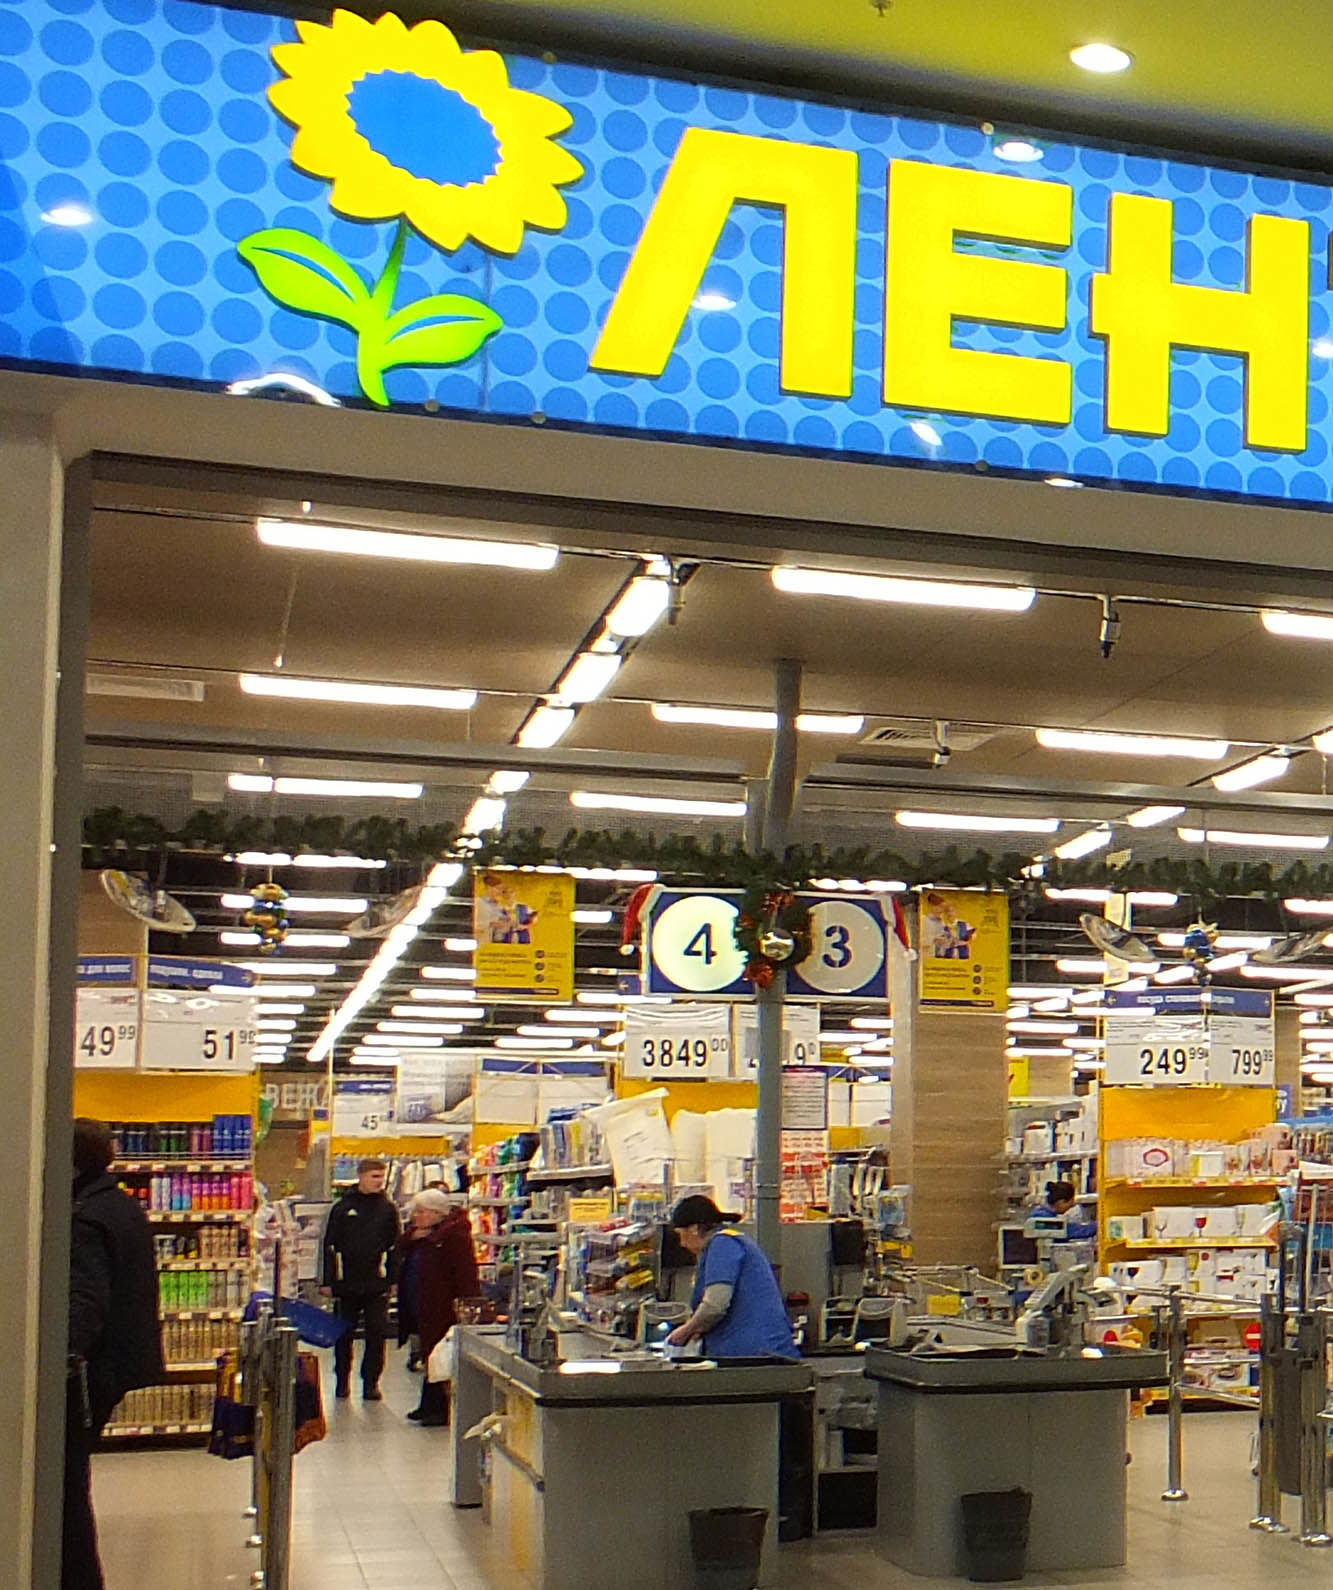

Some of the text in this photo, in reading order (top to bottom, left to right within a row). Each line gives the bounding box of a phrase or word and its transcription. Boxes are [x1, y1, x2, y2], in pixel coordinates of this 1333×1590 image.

[683, 923, 717, 965] 4
[822, 925, 852, 968] 3
[81, 1026, 115, 1057] 49
[203, 1030, 234, 1060] 51
[642, 1039, 707, 1067] 3849
[1140, 1048, 1187, 1075] 249
[1232, 1049, 1262, 1075] 799
